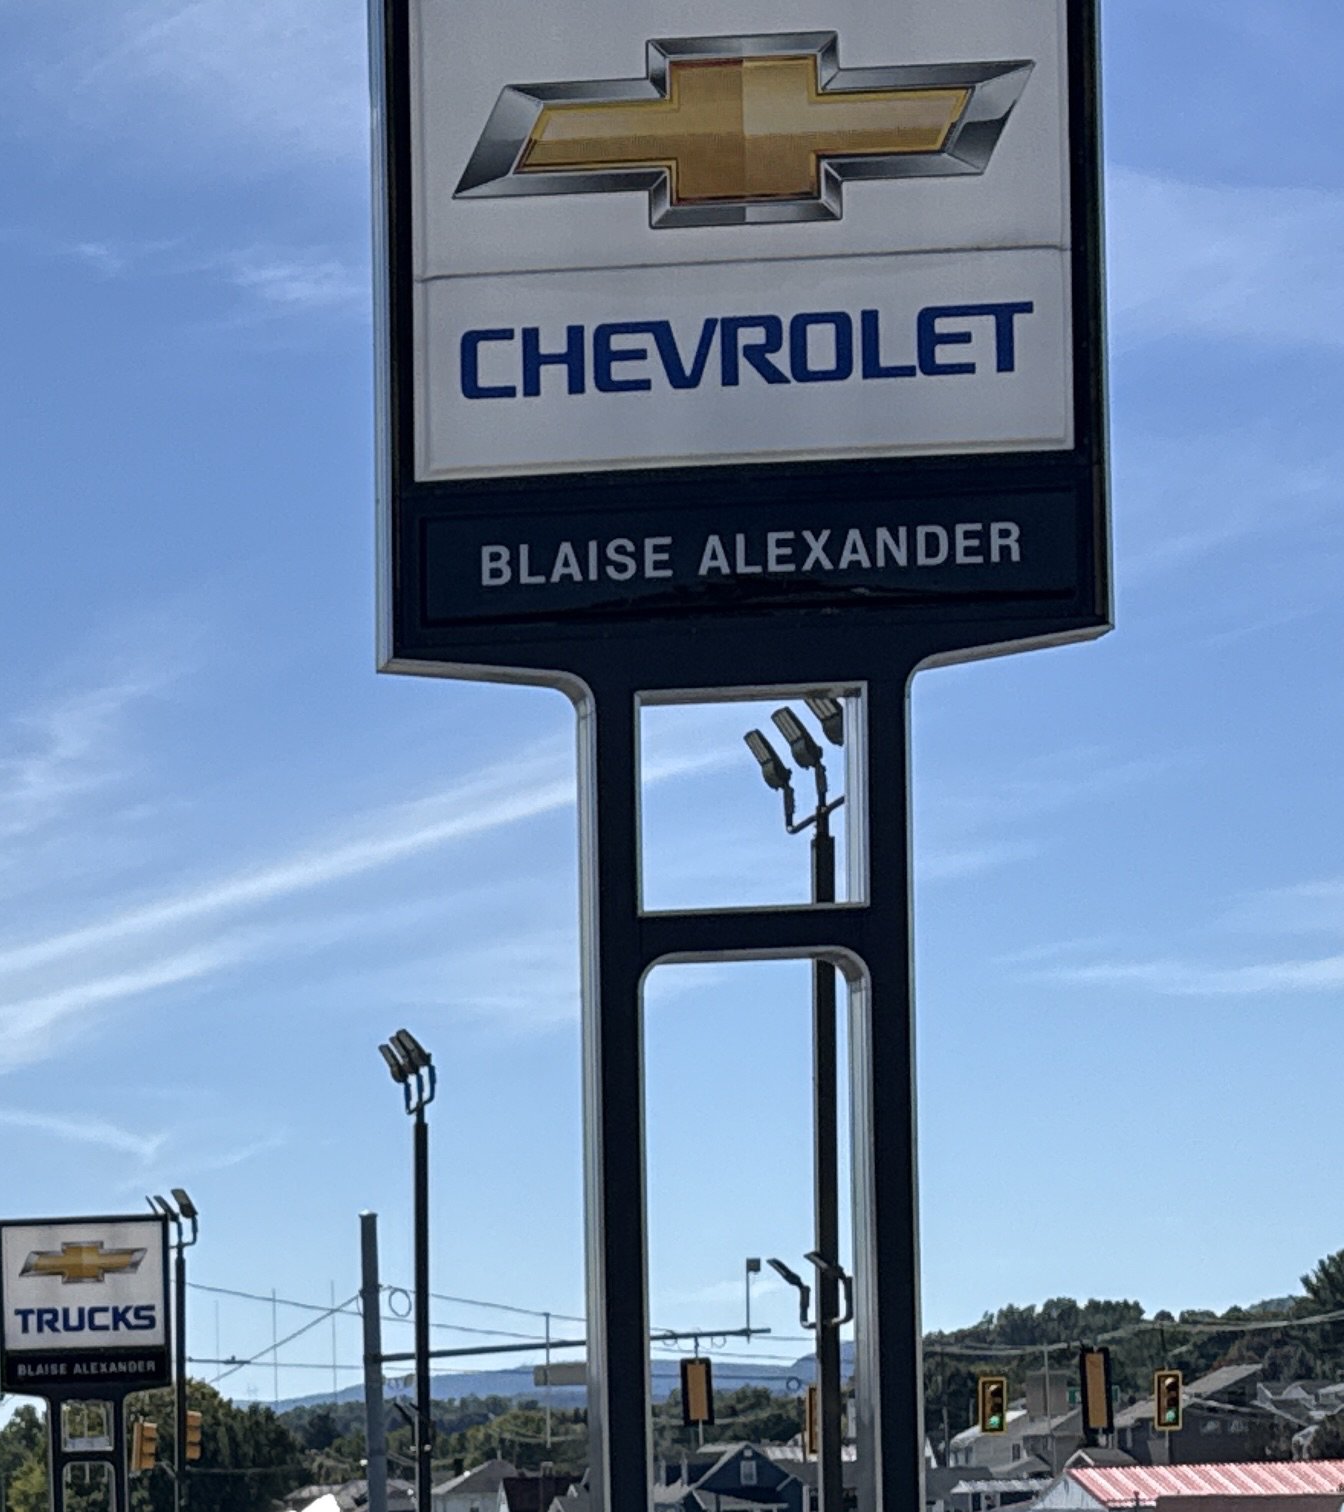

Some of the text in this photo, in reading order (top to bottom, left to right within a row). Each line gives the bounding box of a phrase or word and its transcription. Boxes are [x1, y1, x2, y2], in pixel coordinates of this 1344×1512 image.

[460, 301, 1034, 399] CHEVROLET
[480, 521, 1022, 587] BLAISE ALEXANDER
[14, 1304, 156, 1334] TRUCKS
[17, 1359, 156, 1377] BLAISE ALEXANDER
